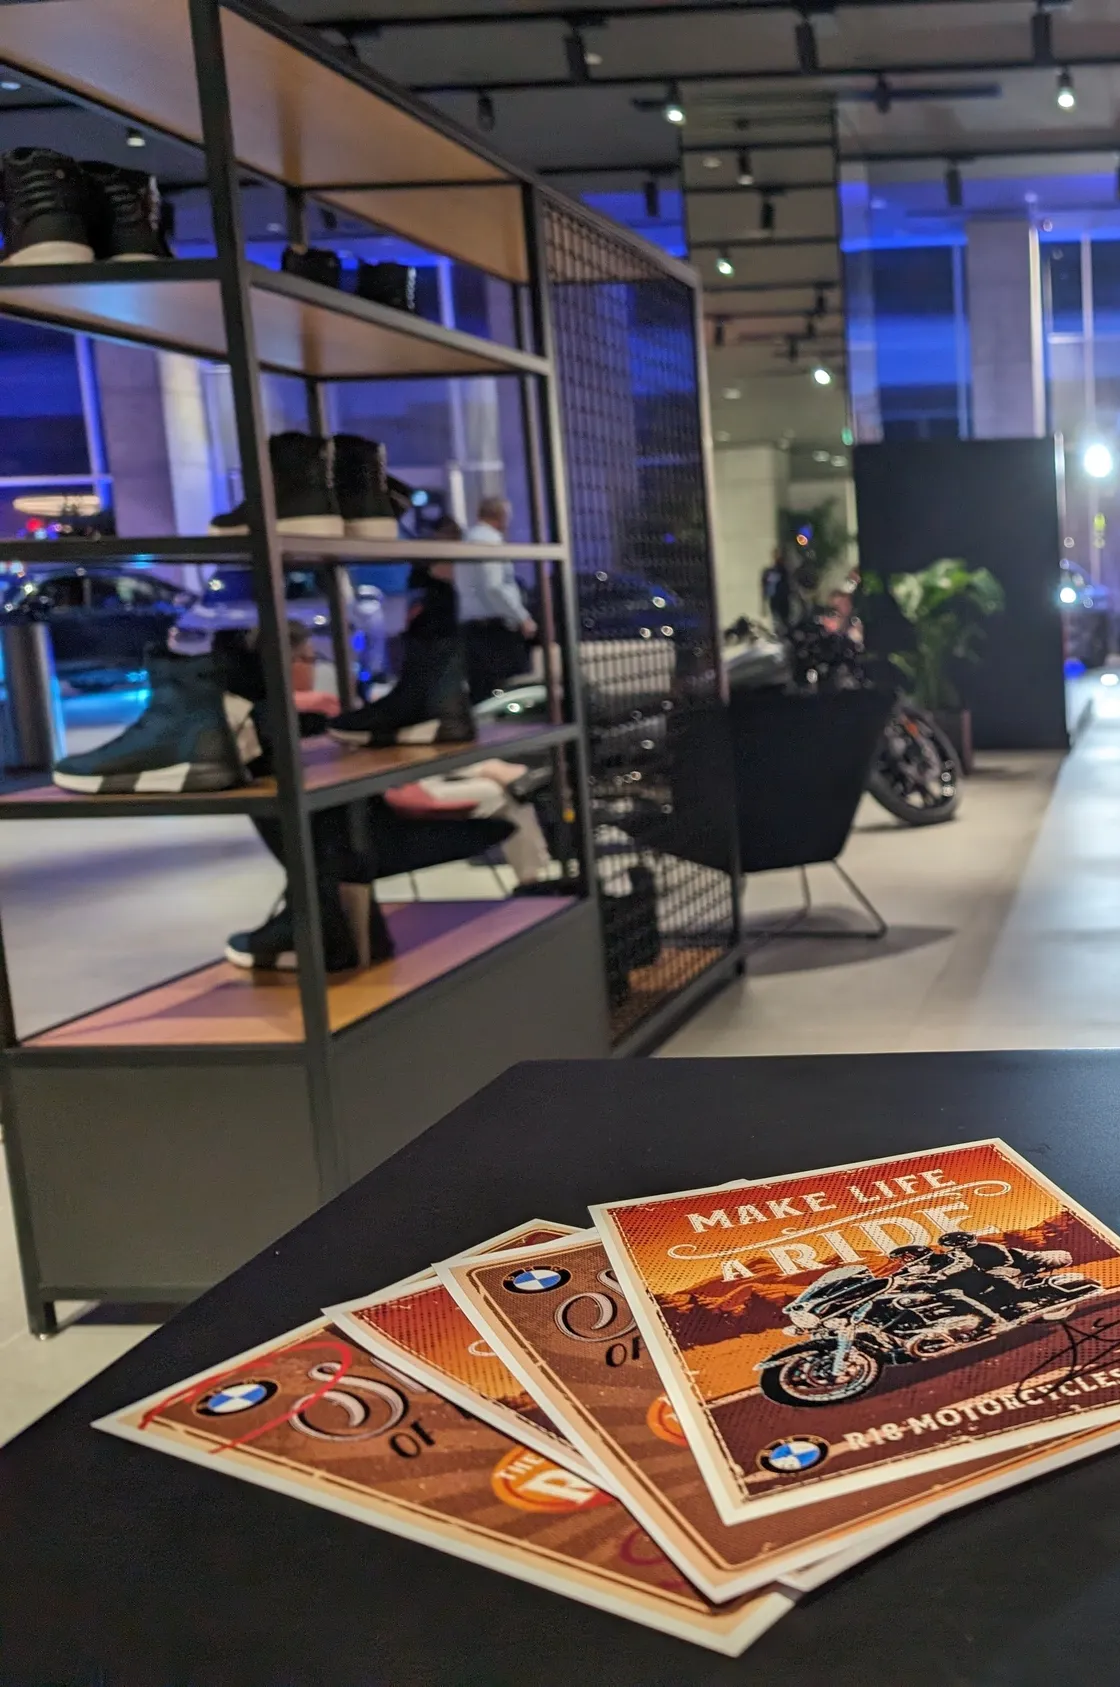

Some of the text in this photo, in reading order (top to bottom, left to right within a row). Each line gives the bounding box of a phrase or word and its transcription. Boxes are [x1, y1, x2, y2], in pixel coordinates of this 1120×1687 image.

[684, 1168, 956, 1234] MAKE LIFE
[720, 1200, 1002, 1283] A RIDE
